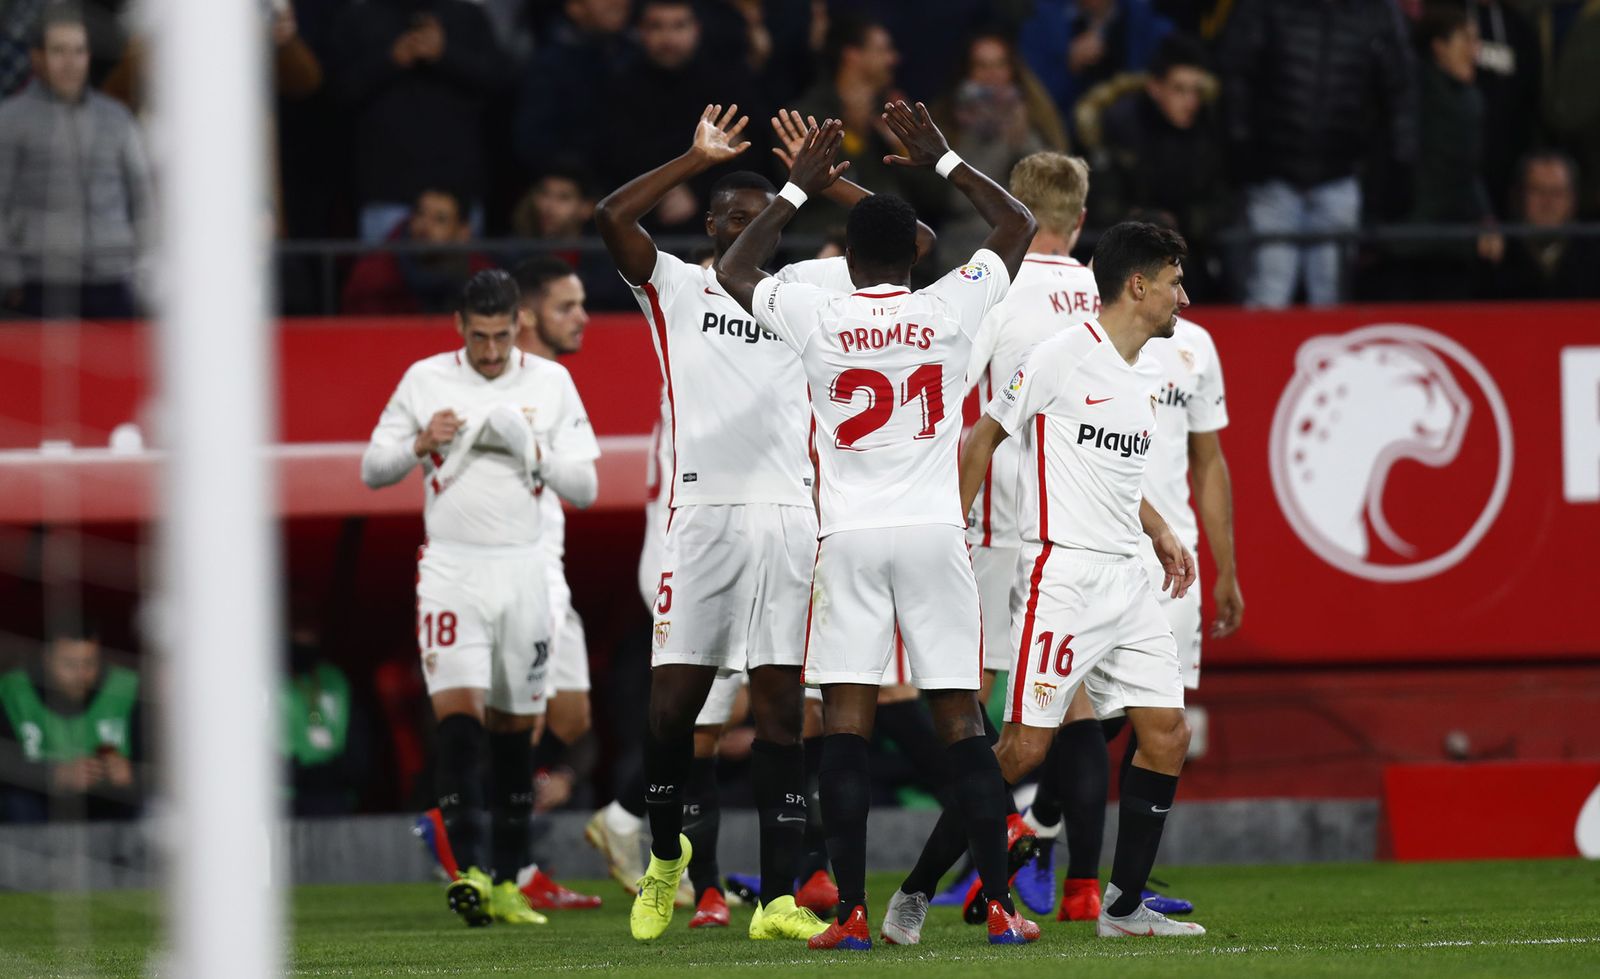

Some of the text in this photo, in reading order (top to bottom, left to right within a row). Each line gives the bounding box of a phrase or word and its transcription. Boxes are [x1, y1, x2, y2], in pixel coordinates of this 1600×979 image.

[1048, 290, 1103, 315] KJÆR
[702, 312, 784, 344] Play
[838, 323, 935, 353] PROMES
[830, 363, 945, 451] 21
[656, 571, 673, 615] 5
[423, 611, 458, 649] 18
[1035, 630, 1075, 678] 16
